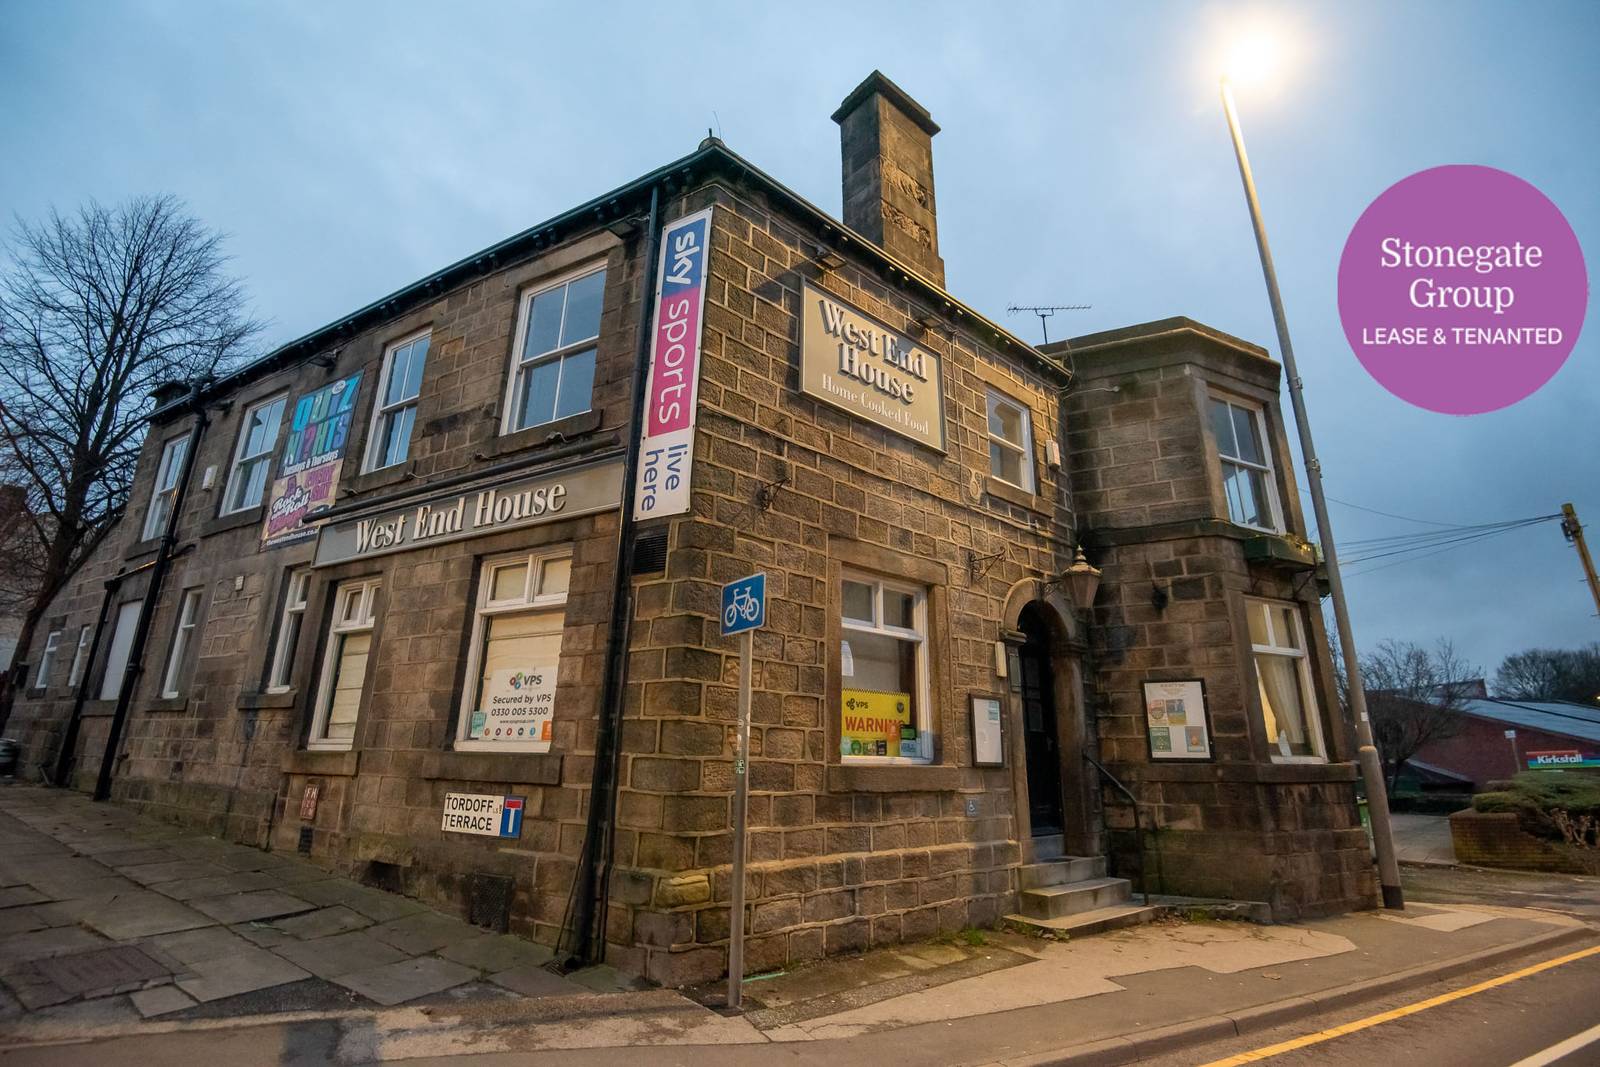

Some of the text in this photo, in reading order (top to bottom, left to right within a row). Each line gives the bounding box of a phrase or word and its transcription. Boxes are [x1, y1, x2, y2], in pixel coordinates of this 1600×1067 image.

[659, 231, 700, 424] sky sports
[819, 299, 928, 381] West End
[838, 343, 914, 404] House
[293, 376, 359, 432] QUIZ
[822, 373, 929, 435] Home Cooked Food
[641, 449, 665, 511] here
[665, 444, 688, 491] live
[273, 487, 302, 512] Rock
[283, 493, 309, 516] Roll
[356, 514, 407, 553] West
[412, 496, 466, 540] End
[473, 484, 566, 528] House
[524, 675, 542, 685] VPS
[492, 707, 548, 716] 0330 005 5300
[493, 694, 551, 704] Secured by VPS
[1537, 754, 1583, 764] Kirkstall
[444, 814, 492, 831] TERRACE
[446, 797, 494, 813] TORDOFF
